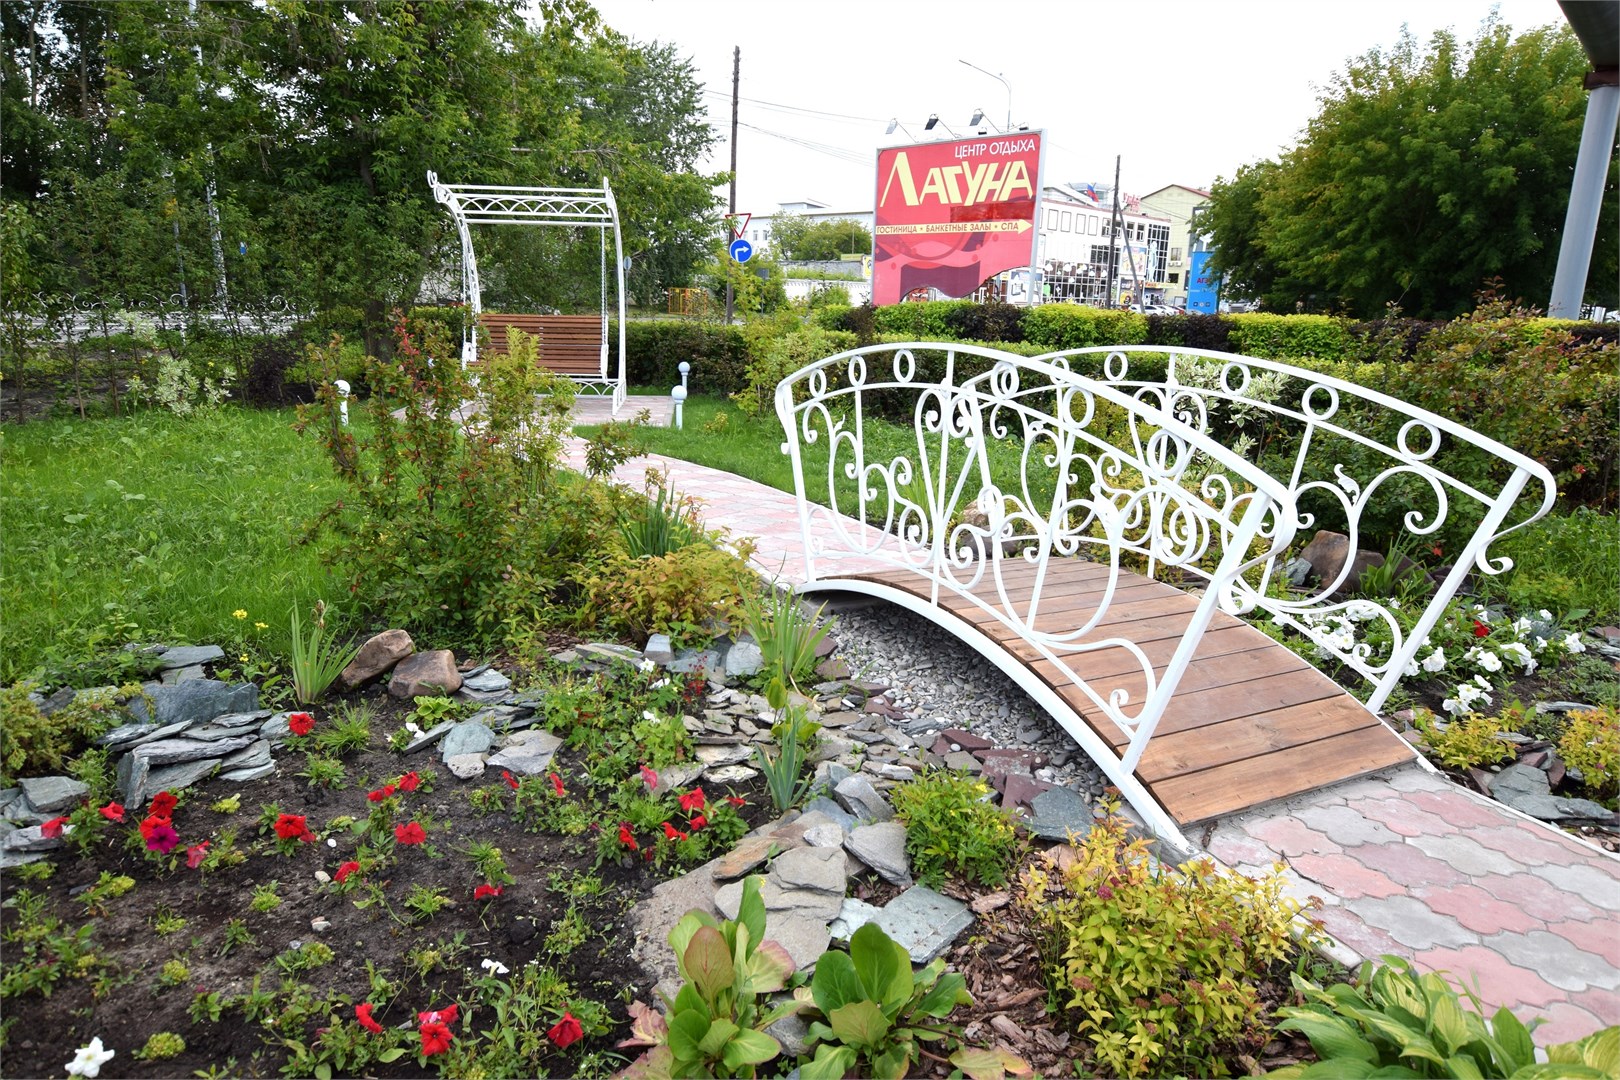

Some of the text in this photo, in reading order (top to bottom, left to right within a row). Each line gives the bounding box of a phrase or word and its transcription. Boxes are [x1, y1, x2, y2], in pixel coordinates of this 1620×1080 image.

[955, 139, 1036, 158] ЦЕНТР ОТДЫХА
[880, 152, 1034, 208] ЛАГУНА
[877, 222, 1020, 234] ГОСТИНИЦА БАНКЕТНЫЕ ЗАЛЫ СПА
